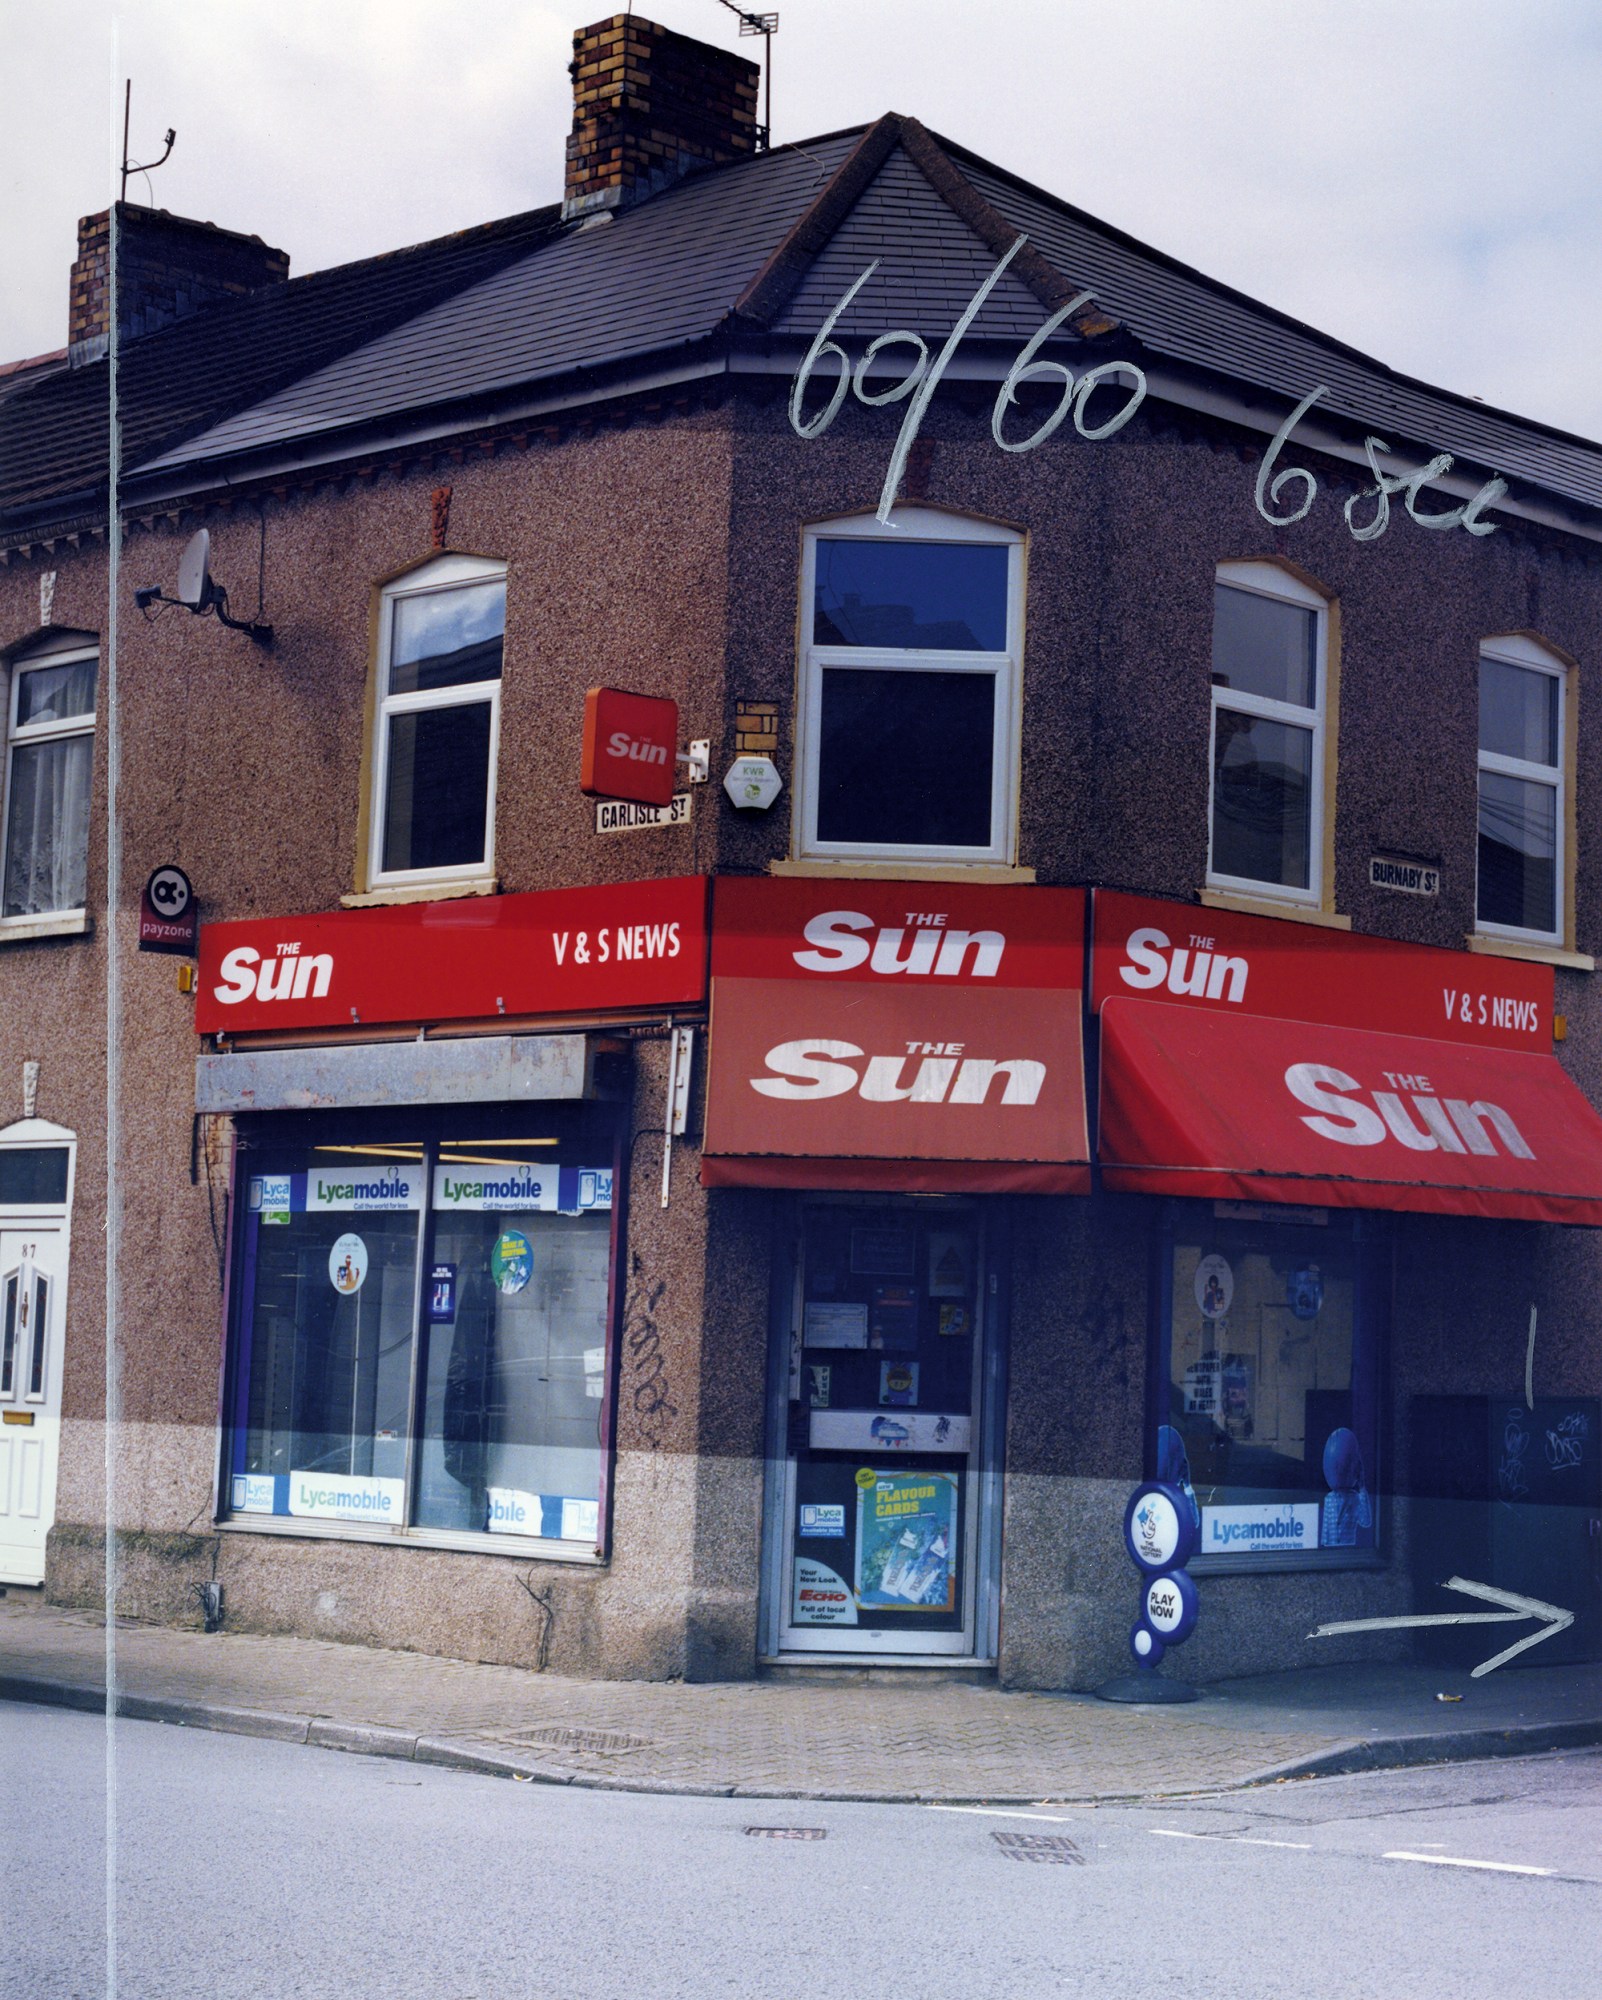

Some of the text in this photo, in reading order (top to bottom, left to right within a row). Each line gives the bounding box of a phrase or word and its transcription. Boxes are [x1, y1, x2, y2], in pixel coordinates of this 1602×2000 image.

[606, 732, 668, 766] Sun
[743, 767, 765, 776] KWR
[601, 804, 661, 829] CARLISLE
[1372, 861, 1423, 890] BURNABY
[905, 912, 948, 926] THE
[142, 921, 193, 939] payzone
[276, 942, 302, 956] THE
[552, 923, 681, 966] V & S NEWS
[792, 911, 1006, 978] Sun
[1188, 935, 1215, 949] THE
[1119, 927, 1248, 1003] Sun
[214, 946, 334, 1005] Sun
[1443, 989, 1538, 1031] V & S NEWS
[905, 1041, 965, 1056] THE
[749, 1039, 1046, 1105] Sun
[1381, 1071, 1434, 1093] THE
[1284, 1063, 1537, 1161] Sun
[264, 1181, 289, 1195] Lyca
[317, 1178, 410, 1204] Lycamobile
[444, 1177, 542, 1202] Lycamobile
[263, 1196, 289, 1206] mobile
[482, 1202, 494, 1210] Call
[22, 1244, 36, 1258] 87
[247, 1480, 272, 1497] Lyca
[876, 1486, 936, 1503] FLAVOUR
[300, 1484, 391, 1511] Lycamobile
[817, 1507, 842, 1517] Lyca
[875, 1501, 919, 1517] CARDS
[1213, 1517, 1304, 1544] Lycamobile
[1250, 1543, 1260, 1551] Call
[800, 1568, 817, 1576] Your
[818, 1576, 837, 1584] Look
[799, 1589, 847, 1602] ECHO
[1150, 1591, 1175, 1607] PLAY
[818, 1605, 827, 1613] of
[827, 1606, 846, 1614] local
[1150, 1605, 1174, 1619] NOW
